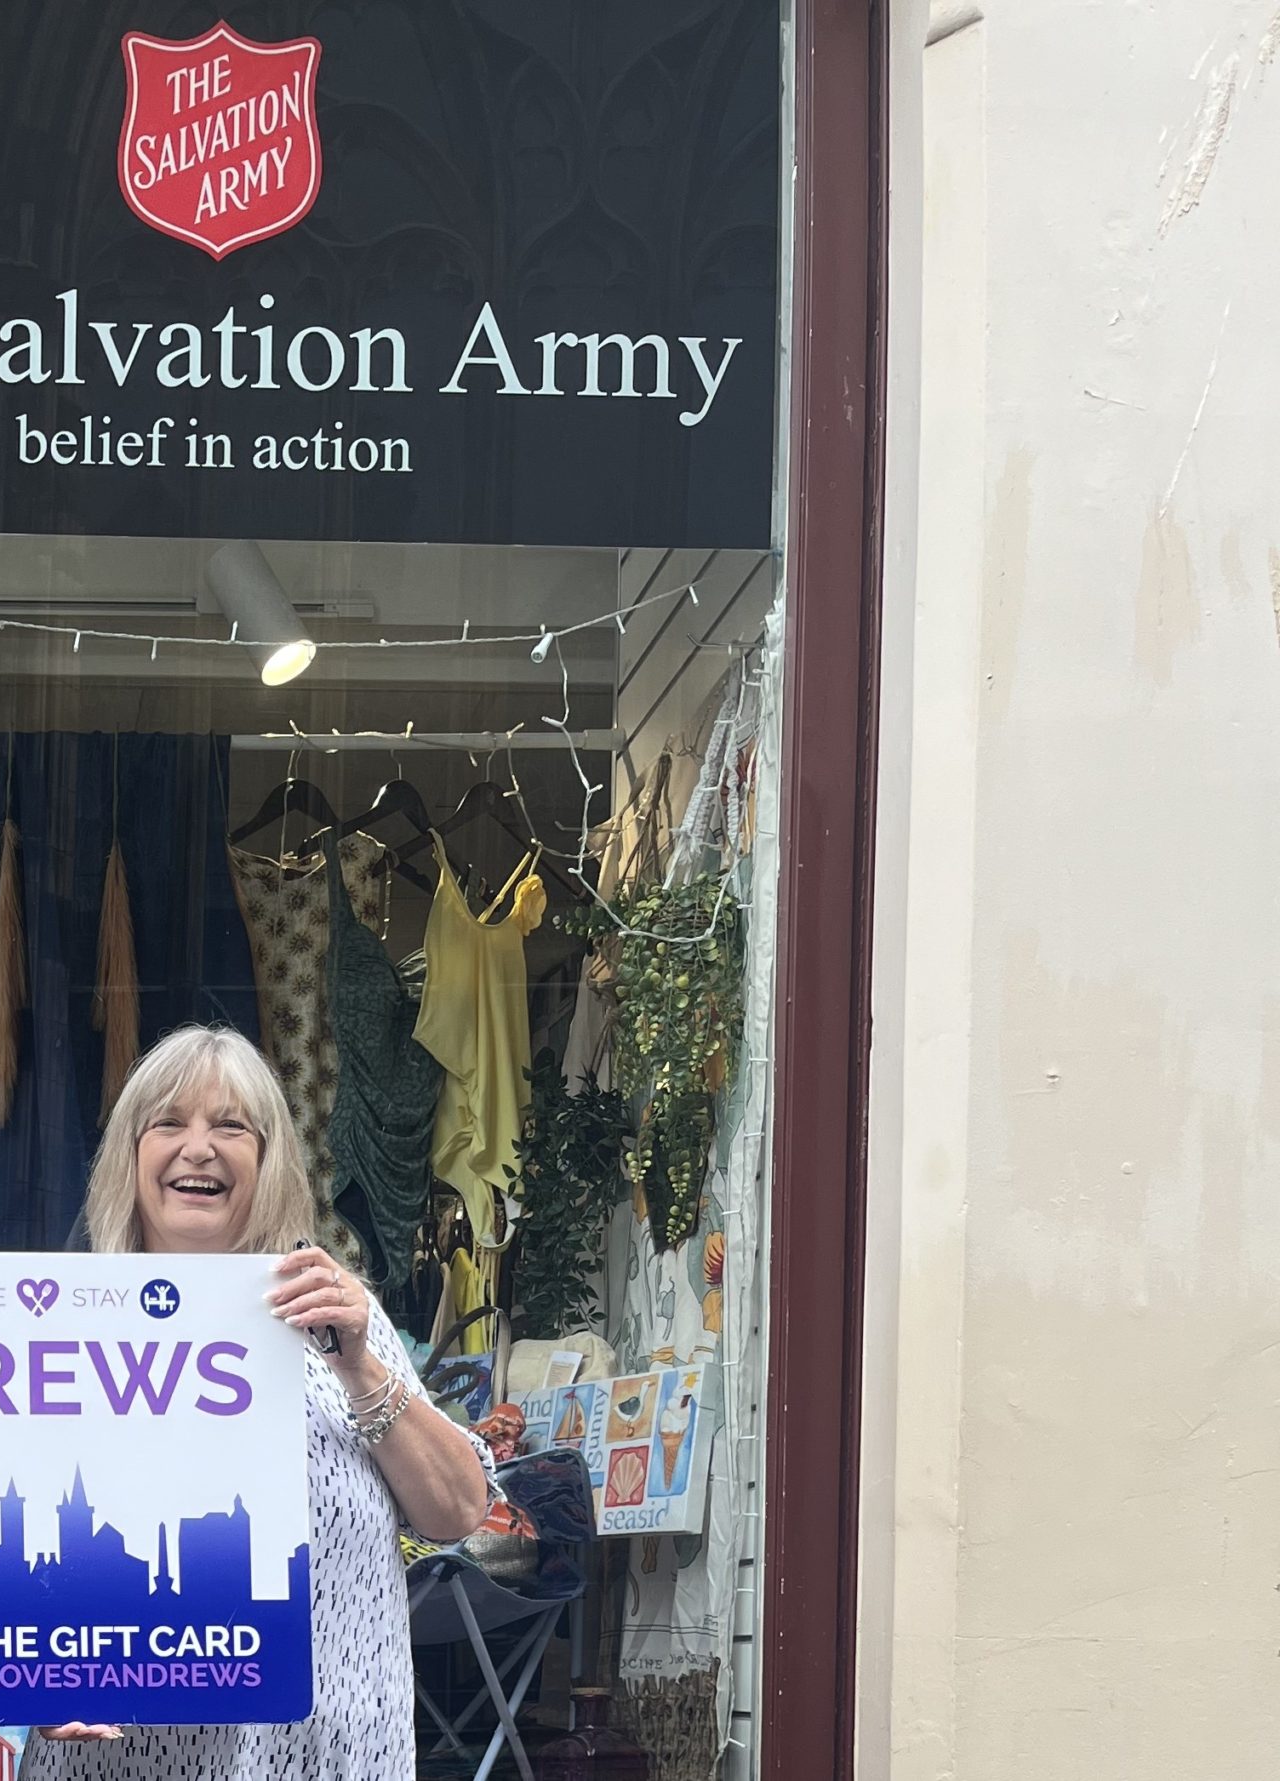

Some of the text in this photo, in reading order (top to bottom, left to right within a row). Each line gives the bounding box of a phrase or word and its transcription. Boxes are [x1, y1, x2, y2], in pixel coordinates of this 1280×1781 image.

[166, 54, 232, 115] THE
[133, 70, 301, 190] SALVATION
[194, 136, 292, 225] ARMY
[438, 301, 743, 427] Army
[15, 413, 414, 472] belief in action
[72, 1288, 130, 1308] STAY
[587, 1388, 609, 1469] Sunny
[49, 1625, 141, 1658] GIFT
[148, 1625, 261, 1657] CARD
